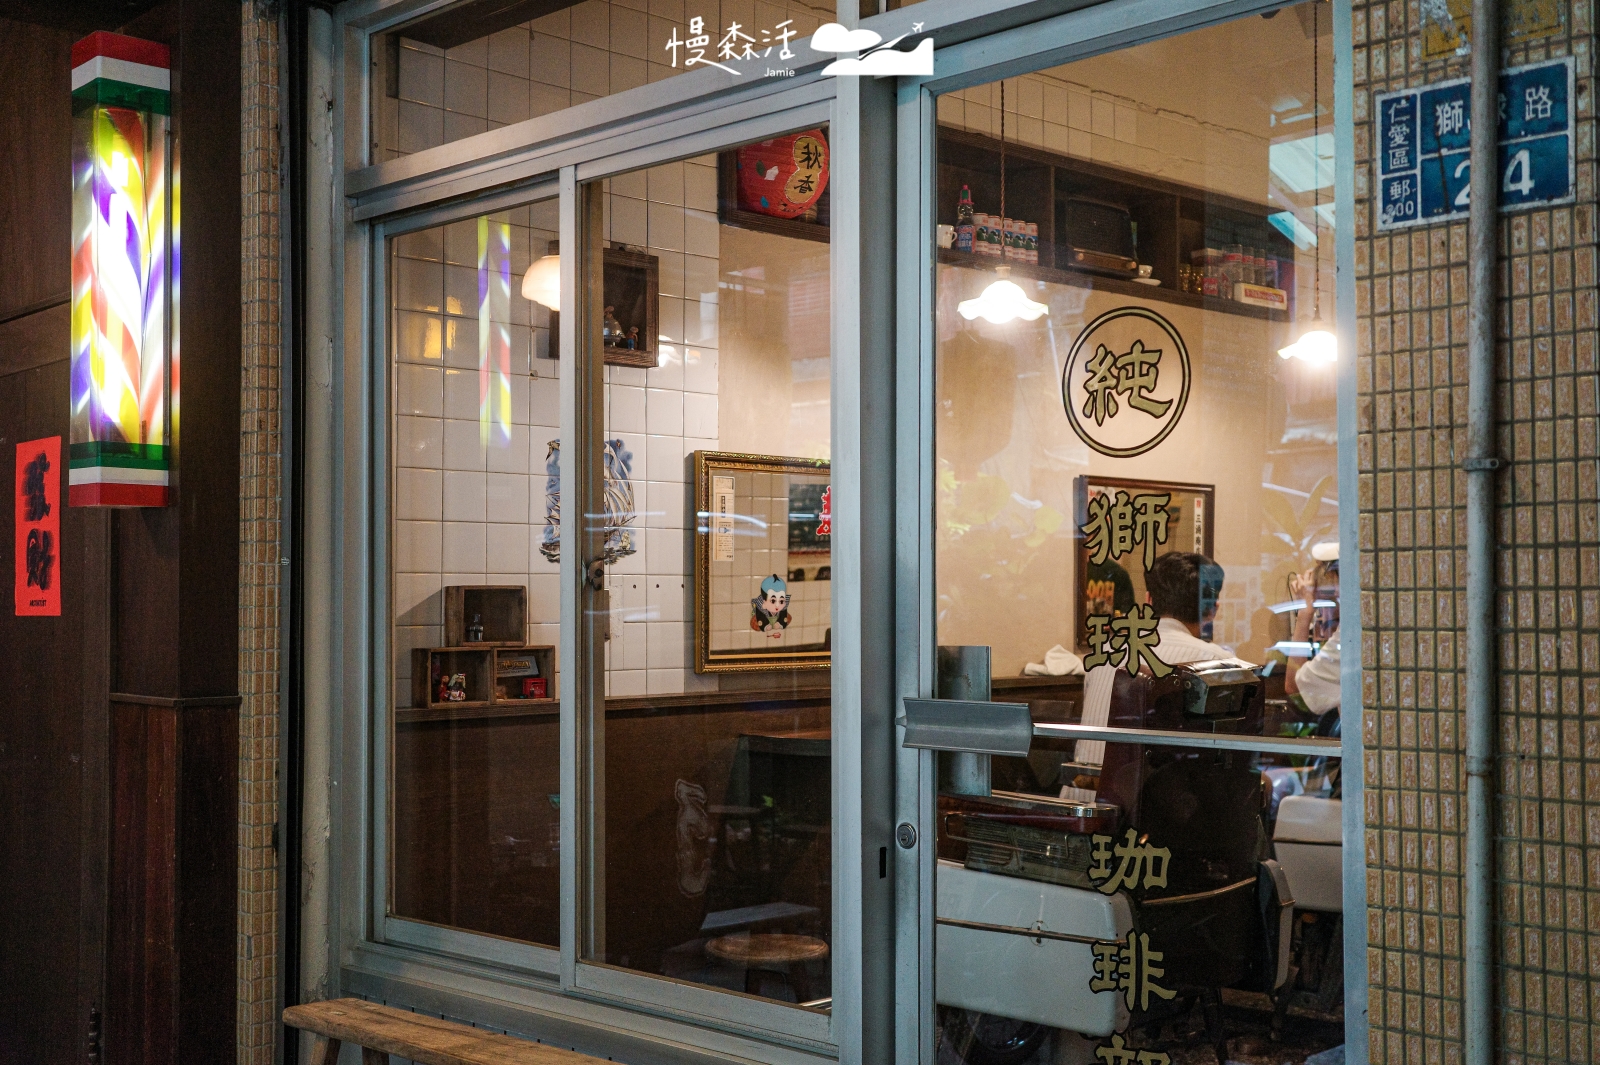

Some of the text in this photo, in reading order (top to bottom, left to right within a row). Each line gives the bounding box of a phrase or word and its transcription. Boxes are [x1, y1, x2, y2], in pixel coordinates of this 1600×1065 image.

[793, 143, 822, 194] 秋香
[1388, 99, 1411, 171] 仁愛區
[1454, 149, 1535, 206] 24
[1082, 339, 1173, 427] 純
[1079, 490, 1176, 678] 獅球
